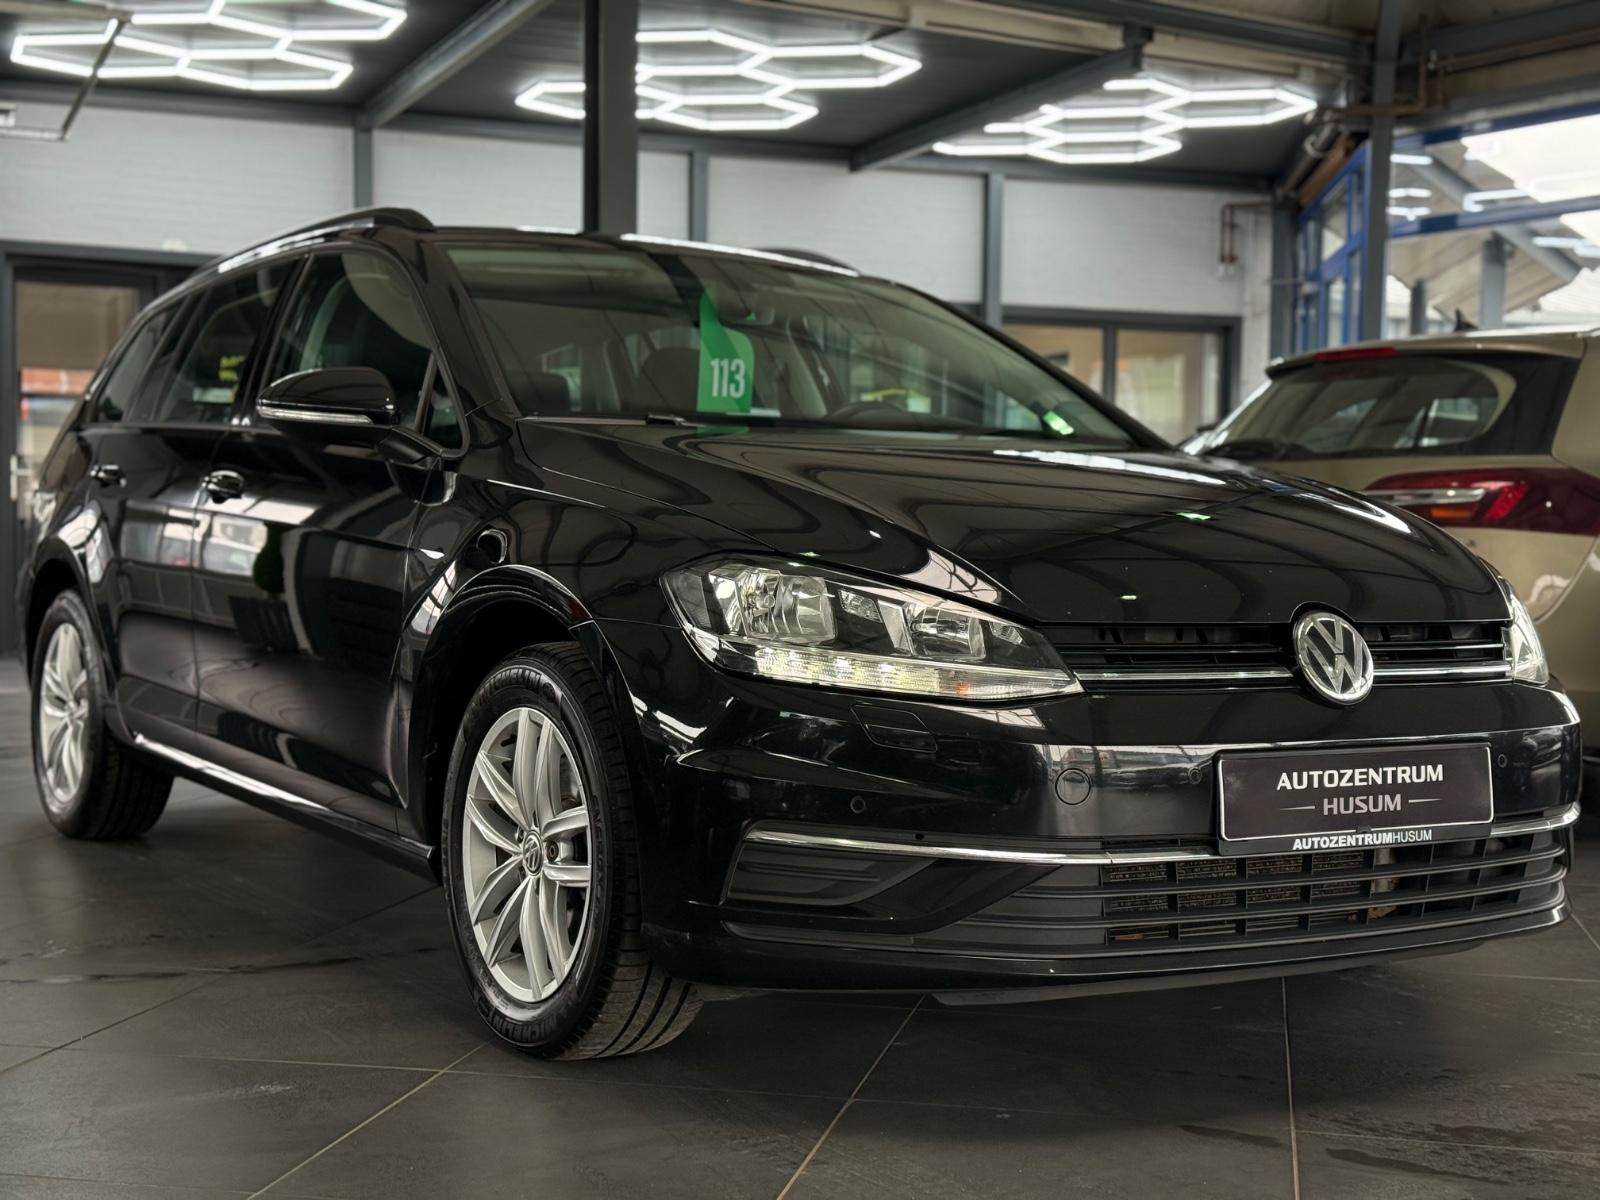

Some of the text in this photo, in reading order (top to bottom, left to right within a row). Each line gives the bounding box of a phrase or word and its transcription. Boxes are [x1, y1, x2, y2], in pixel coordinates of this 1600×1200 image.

[710, 358, 746, 399] 113
[1276, 764, 1444, 791] AUTOZENTRUM
[1322, 793, 1402, 816] HUSUM
[1292, 829, 1433, 851] AUTOZENTRUMHUSUM
